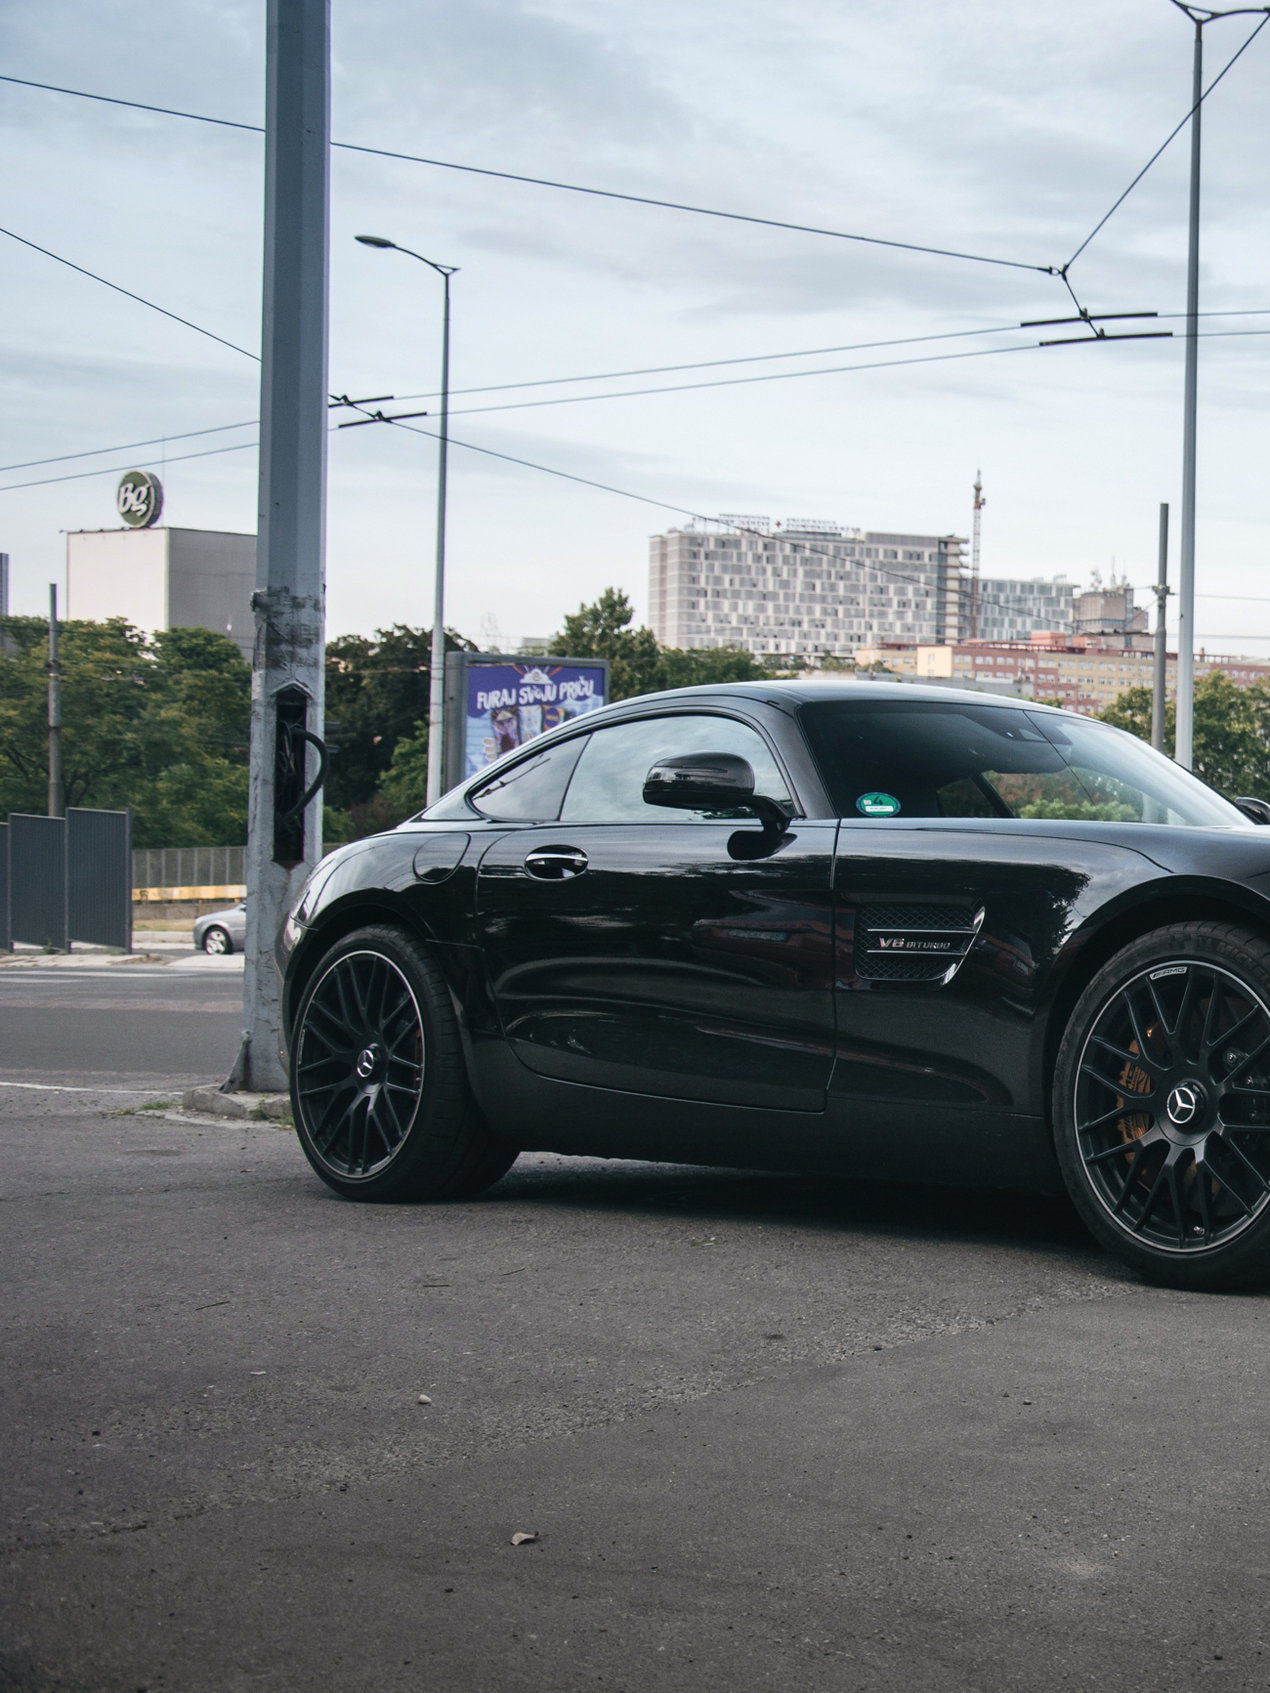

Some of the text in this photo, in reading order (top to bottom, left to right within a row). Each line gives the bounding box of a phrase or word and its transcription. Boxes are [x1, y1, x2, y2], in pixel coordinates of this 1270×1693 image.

[476, 688, 517, 710] FURAJ
[873, 795, 884, 806] 4
[879, 937, 905, 948] V8
